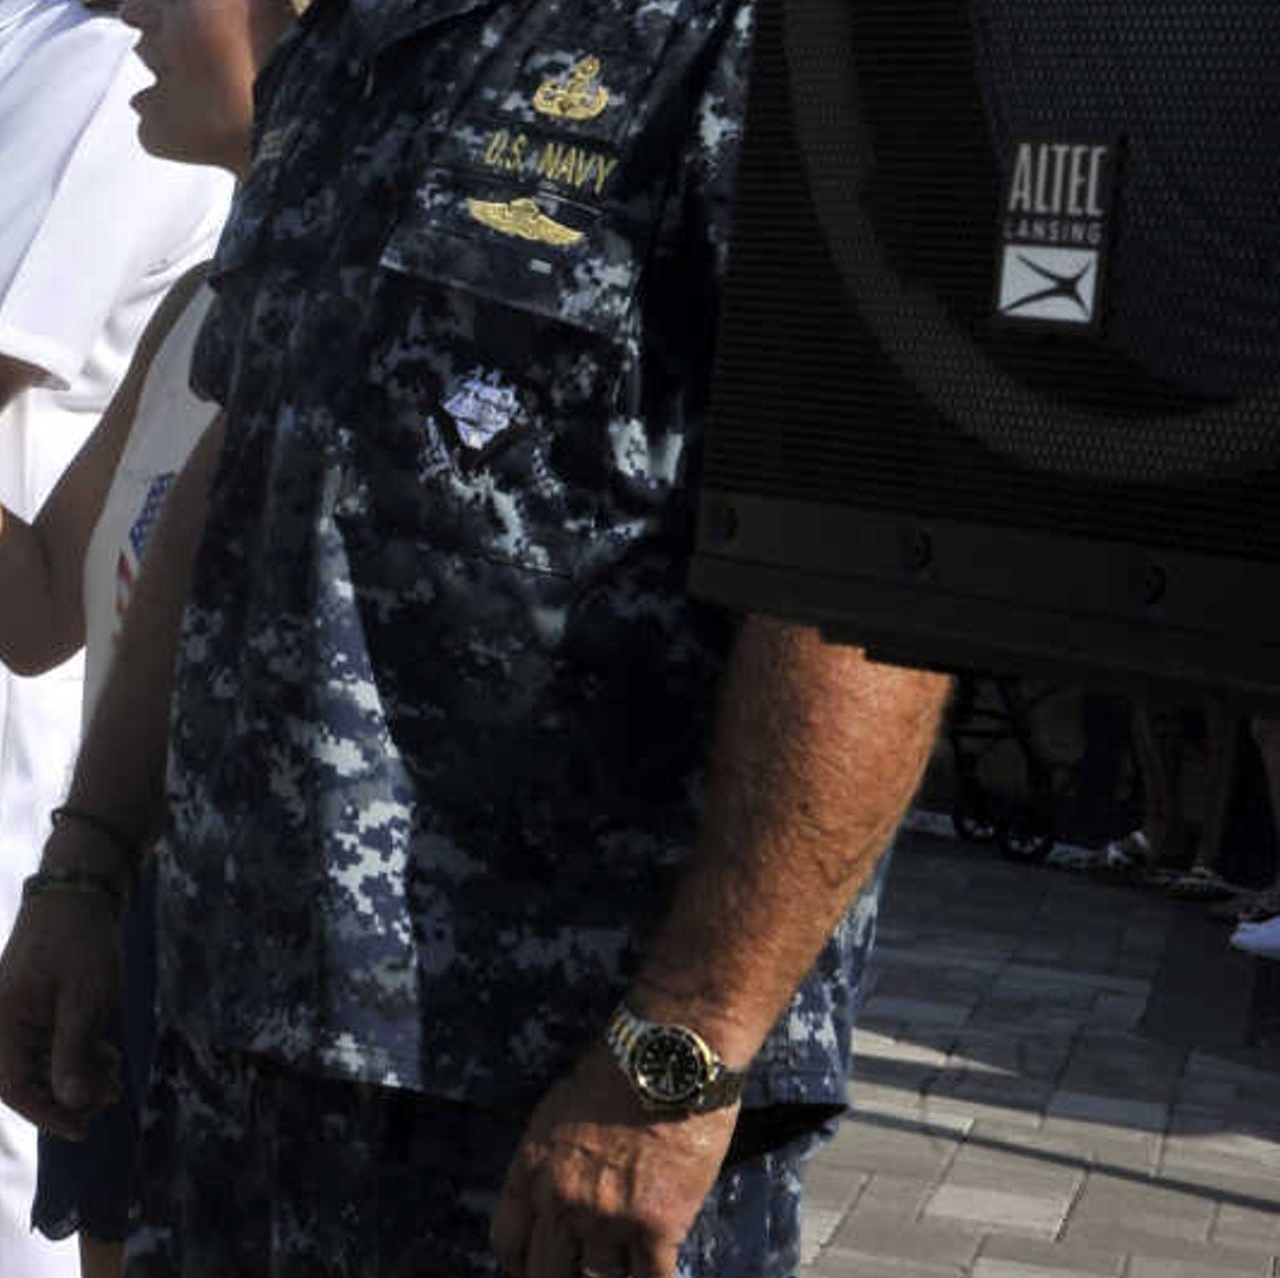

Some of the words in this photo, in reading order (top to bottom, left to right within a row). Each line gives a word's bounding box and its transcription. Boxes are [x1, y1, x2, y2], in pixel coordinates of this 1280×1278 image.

[483, 129, 529, 174] U.S.
[537, 142, 619, 195] NAVY
[1006, 142, 1108, 217] ALTEC
[1002, 219, 1103, 245] LANSING
